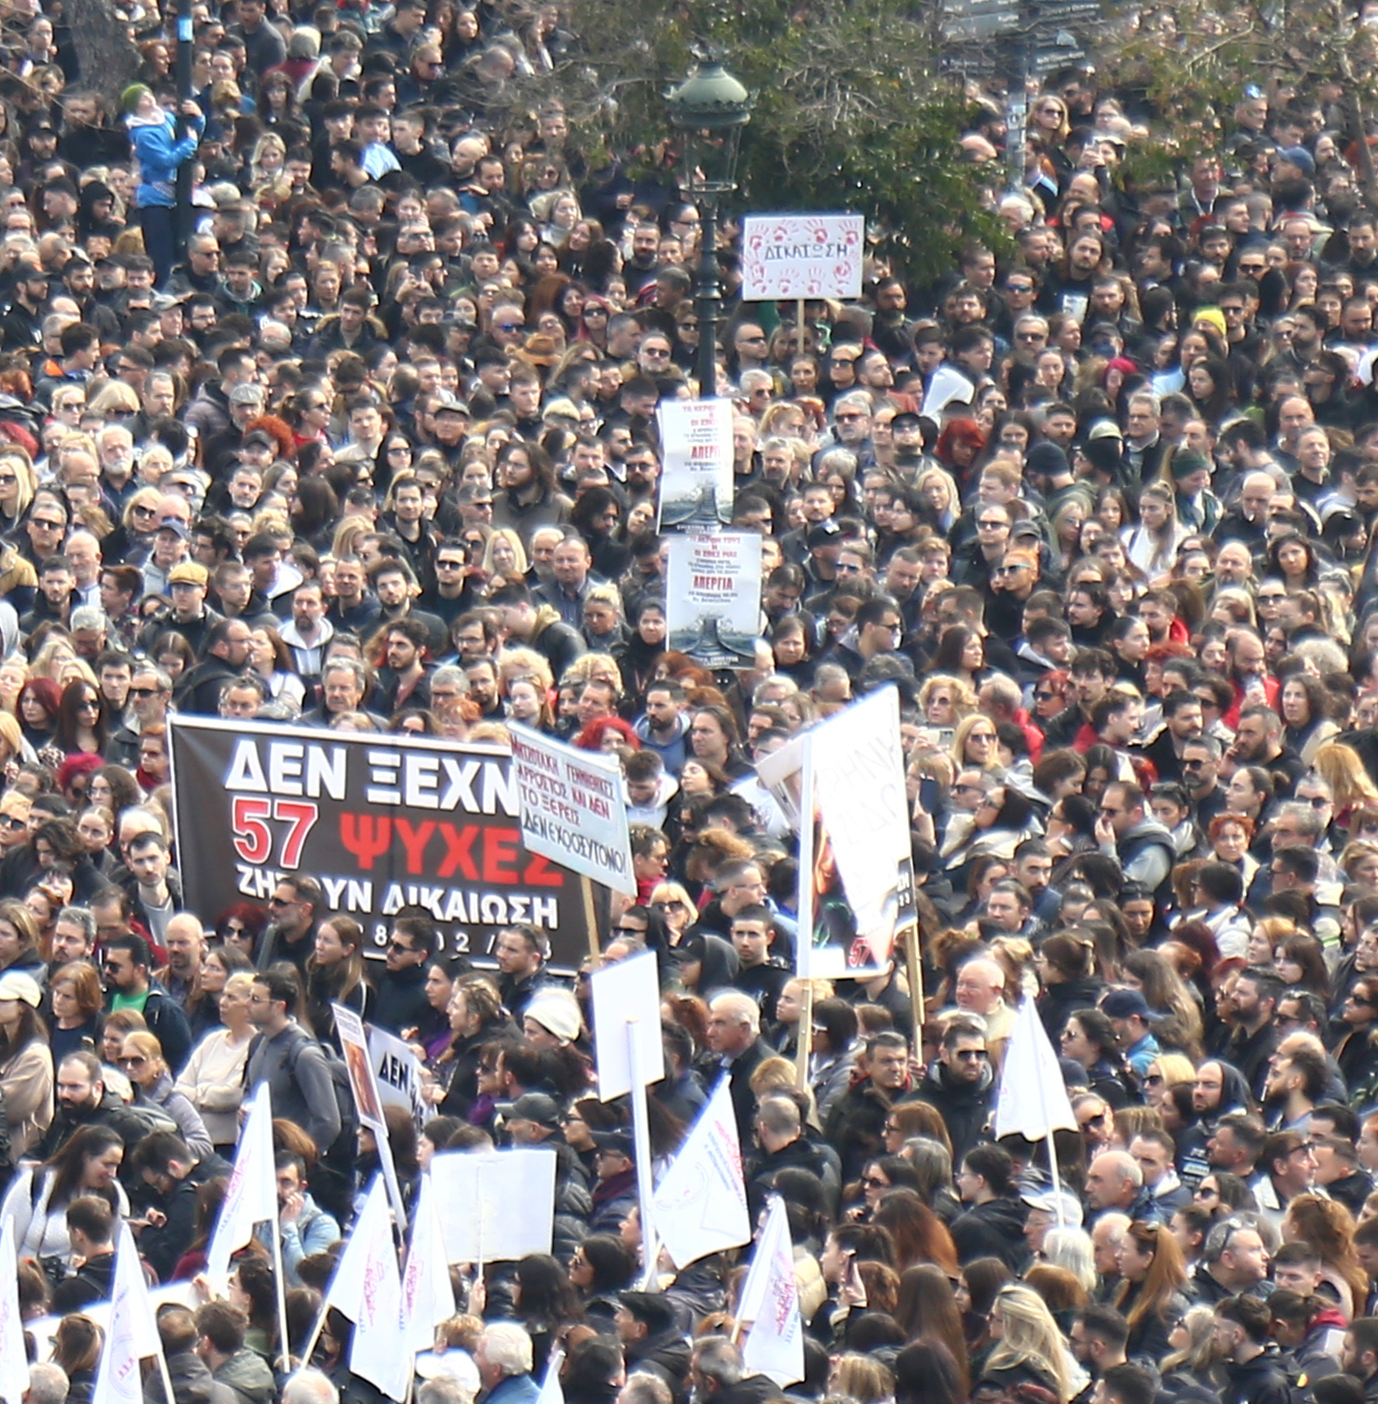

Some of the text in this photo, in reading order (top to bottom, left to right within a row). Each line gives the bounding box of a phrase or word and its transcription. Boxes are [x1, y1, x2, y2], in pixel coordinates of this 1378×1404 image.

[765, 242, 848, 260] ΔΙΚΑΙΩΣΗ
[225, 739, 520, 818] ΔΕΝ ΞΕΧΝ
[521, 784, 581, 827] ΤΟ ΞΕΡΕΙΣ
[588, 794, 611, 821] ΔΕΝ
[231, 796, 564, 888] 57 ΨΥΧΕΣ
[234, 863, 559, 930] ΖΗΥΝ ΔΙΚΑΙΩΣΗ
